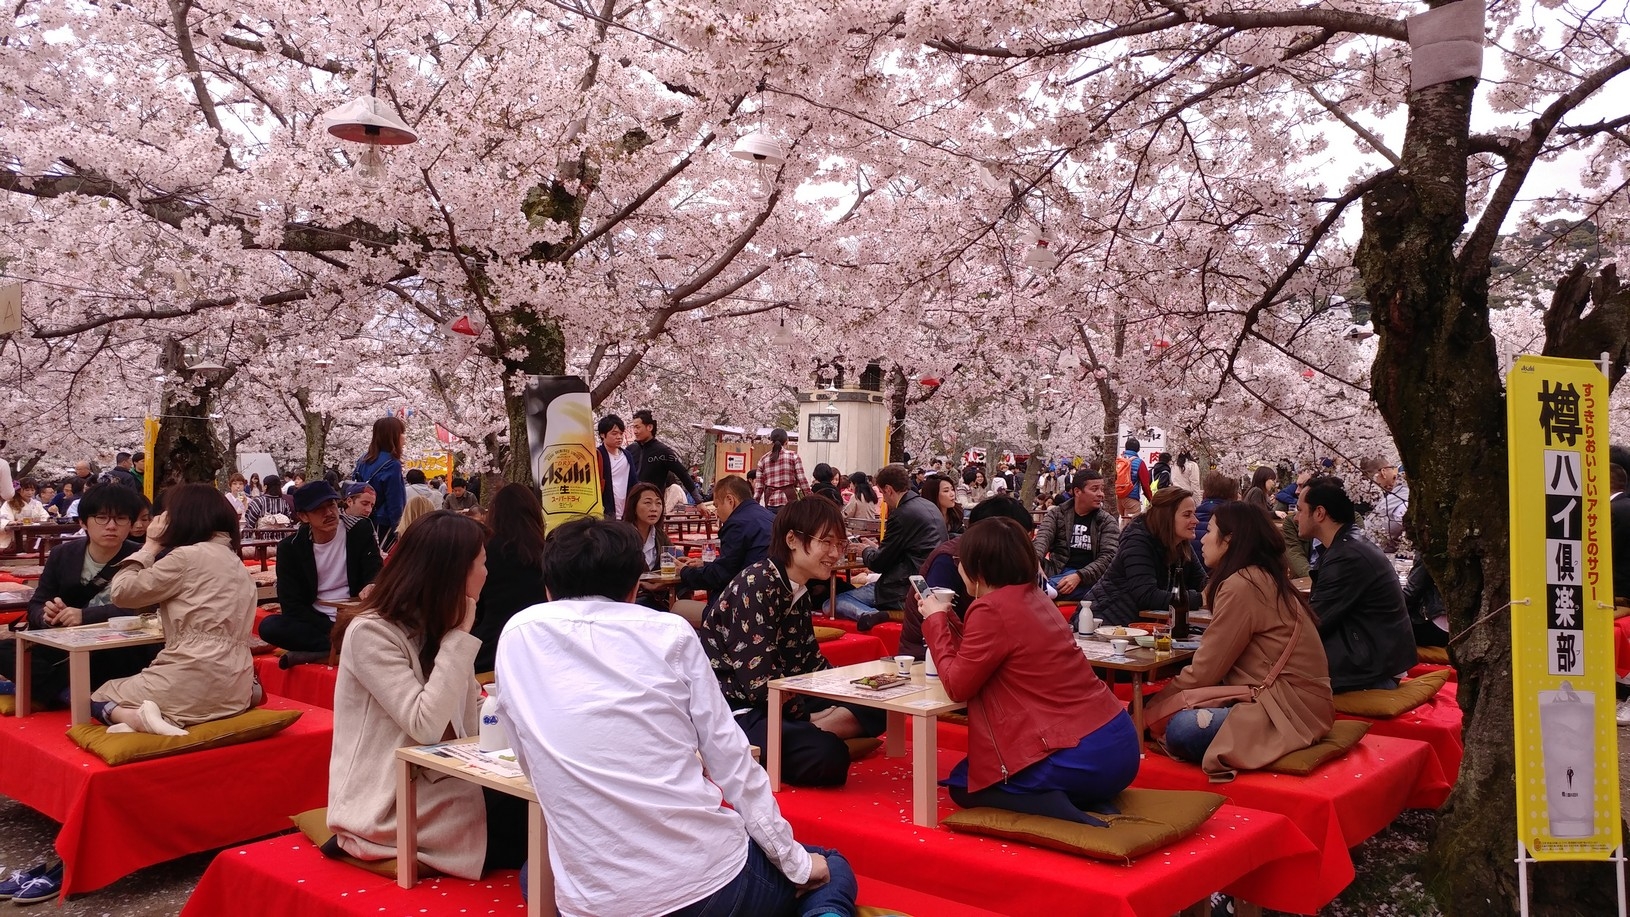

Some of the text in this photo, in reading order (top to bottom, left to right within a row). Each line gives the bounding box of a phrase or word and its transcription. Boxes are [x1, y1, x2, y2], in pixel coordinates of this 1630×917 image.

[541, 461, 591, 487] Asahi
[560, 484, 570, 494] 生
[1582, 383, 1600, 600] すっきりおいしいアサヒのサワー
